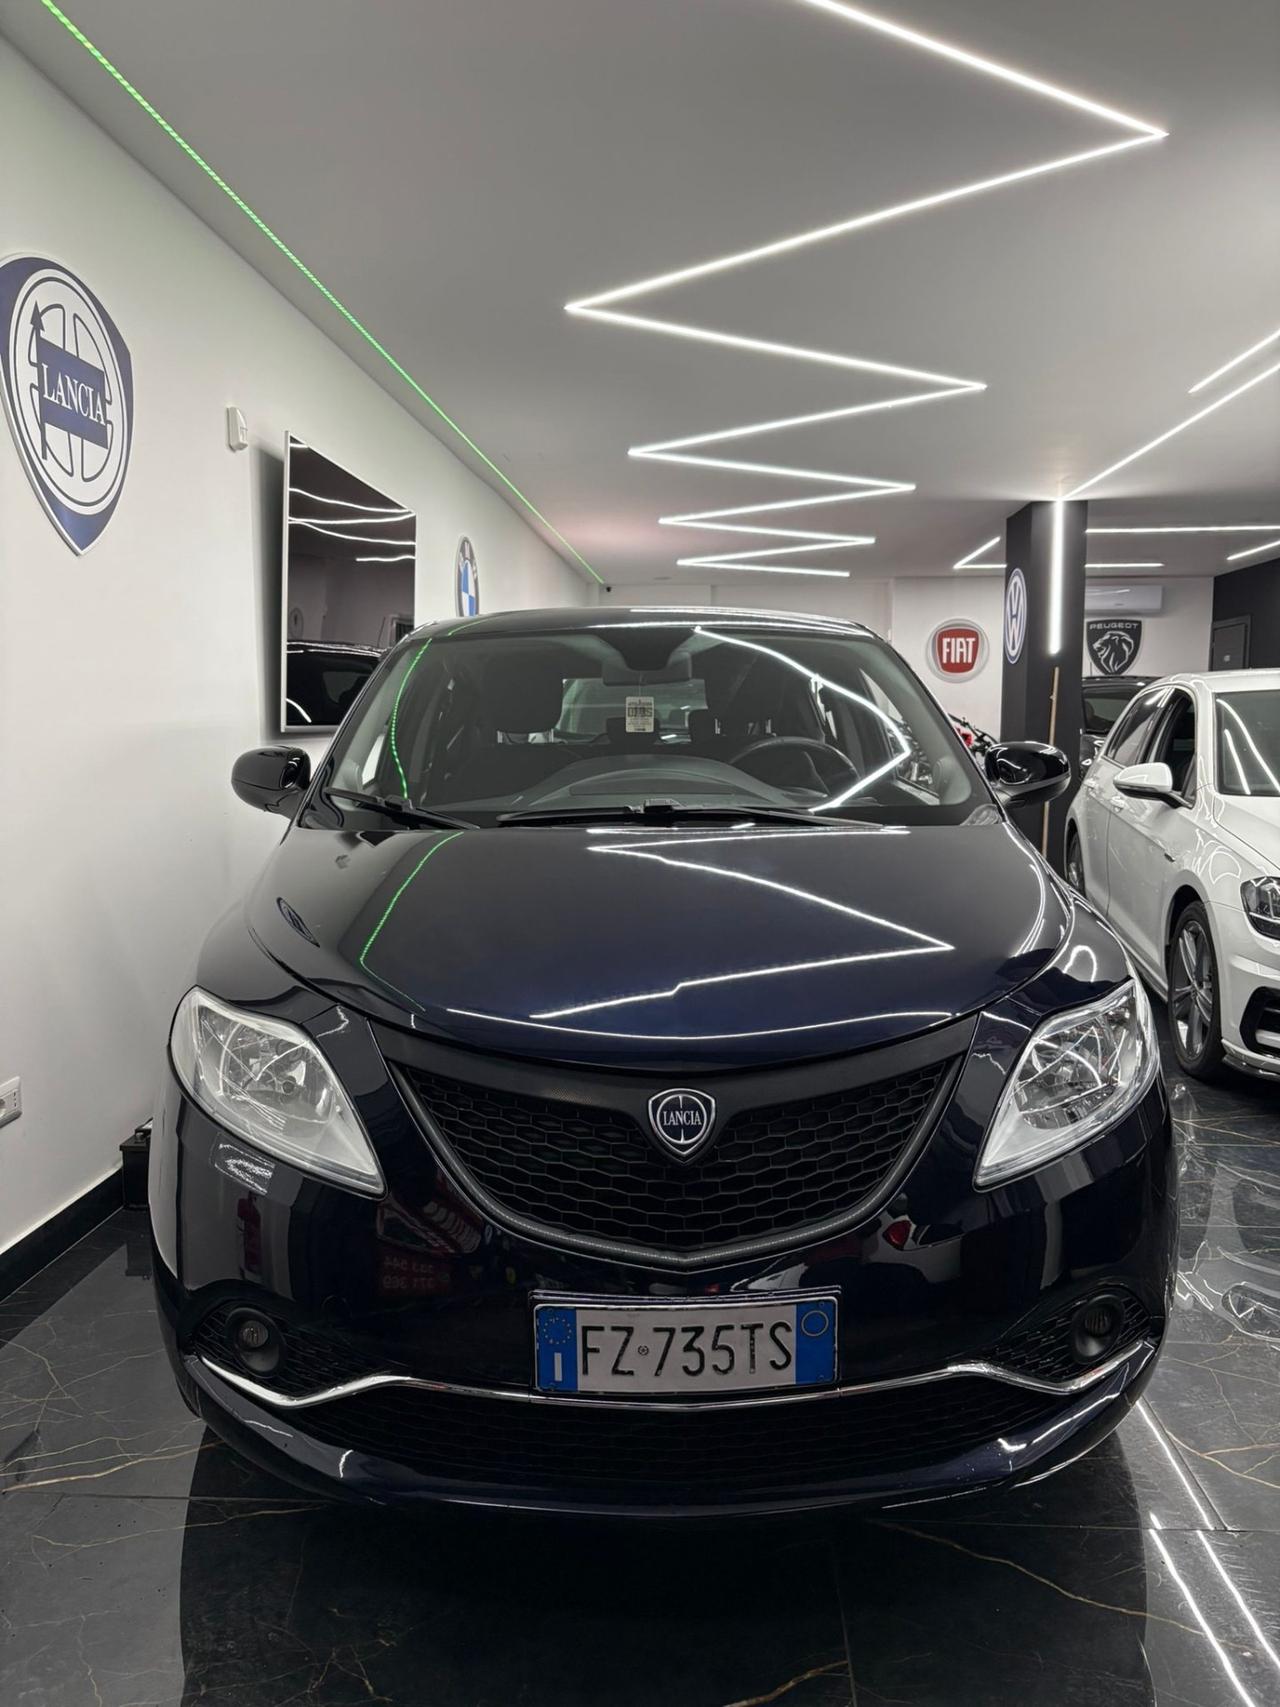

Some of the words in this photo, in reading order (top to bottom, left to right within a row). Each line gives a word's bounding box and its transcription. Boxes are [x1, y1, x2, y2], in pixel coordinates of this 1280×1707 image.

[41, 362, 107, 426] LANCIA
[1089, 622, 1139, 630] PEUGEOT
[942, 637, 976, 664] FIAT
[662, 1110, 703, 1126] LANCIA
